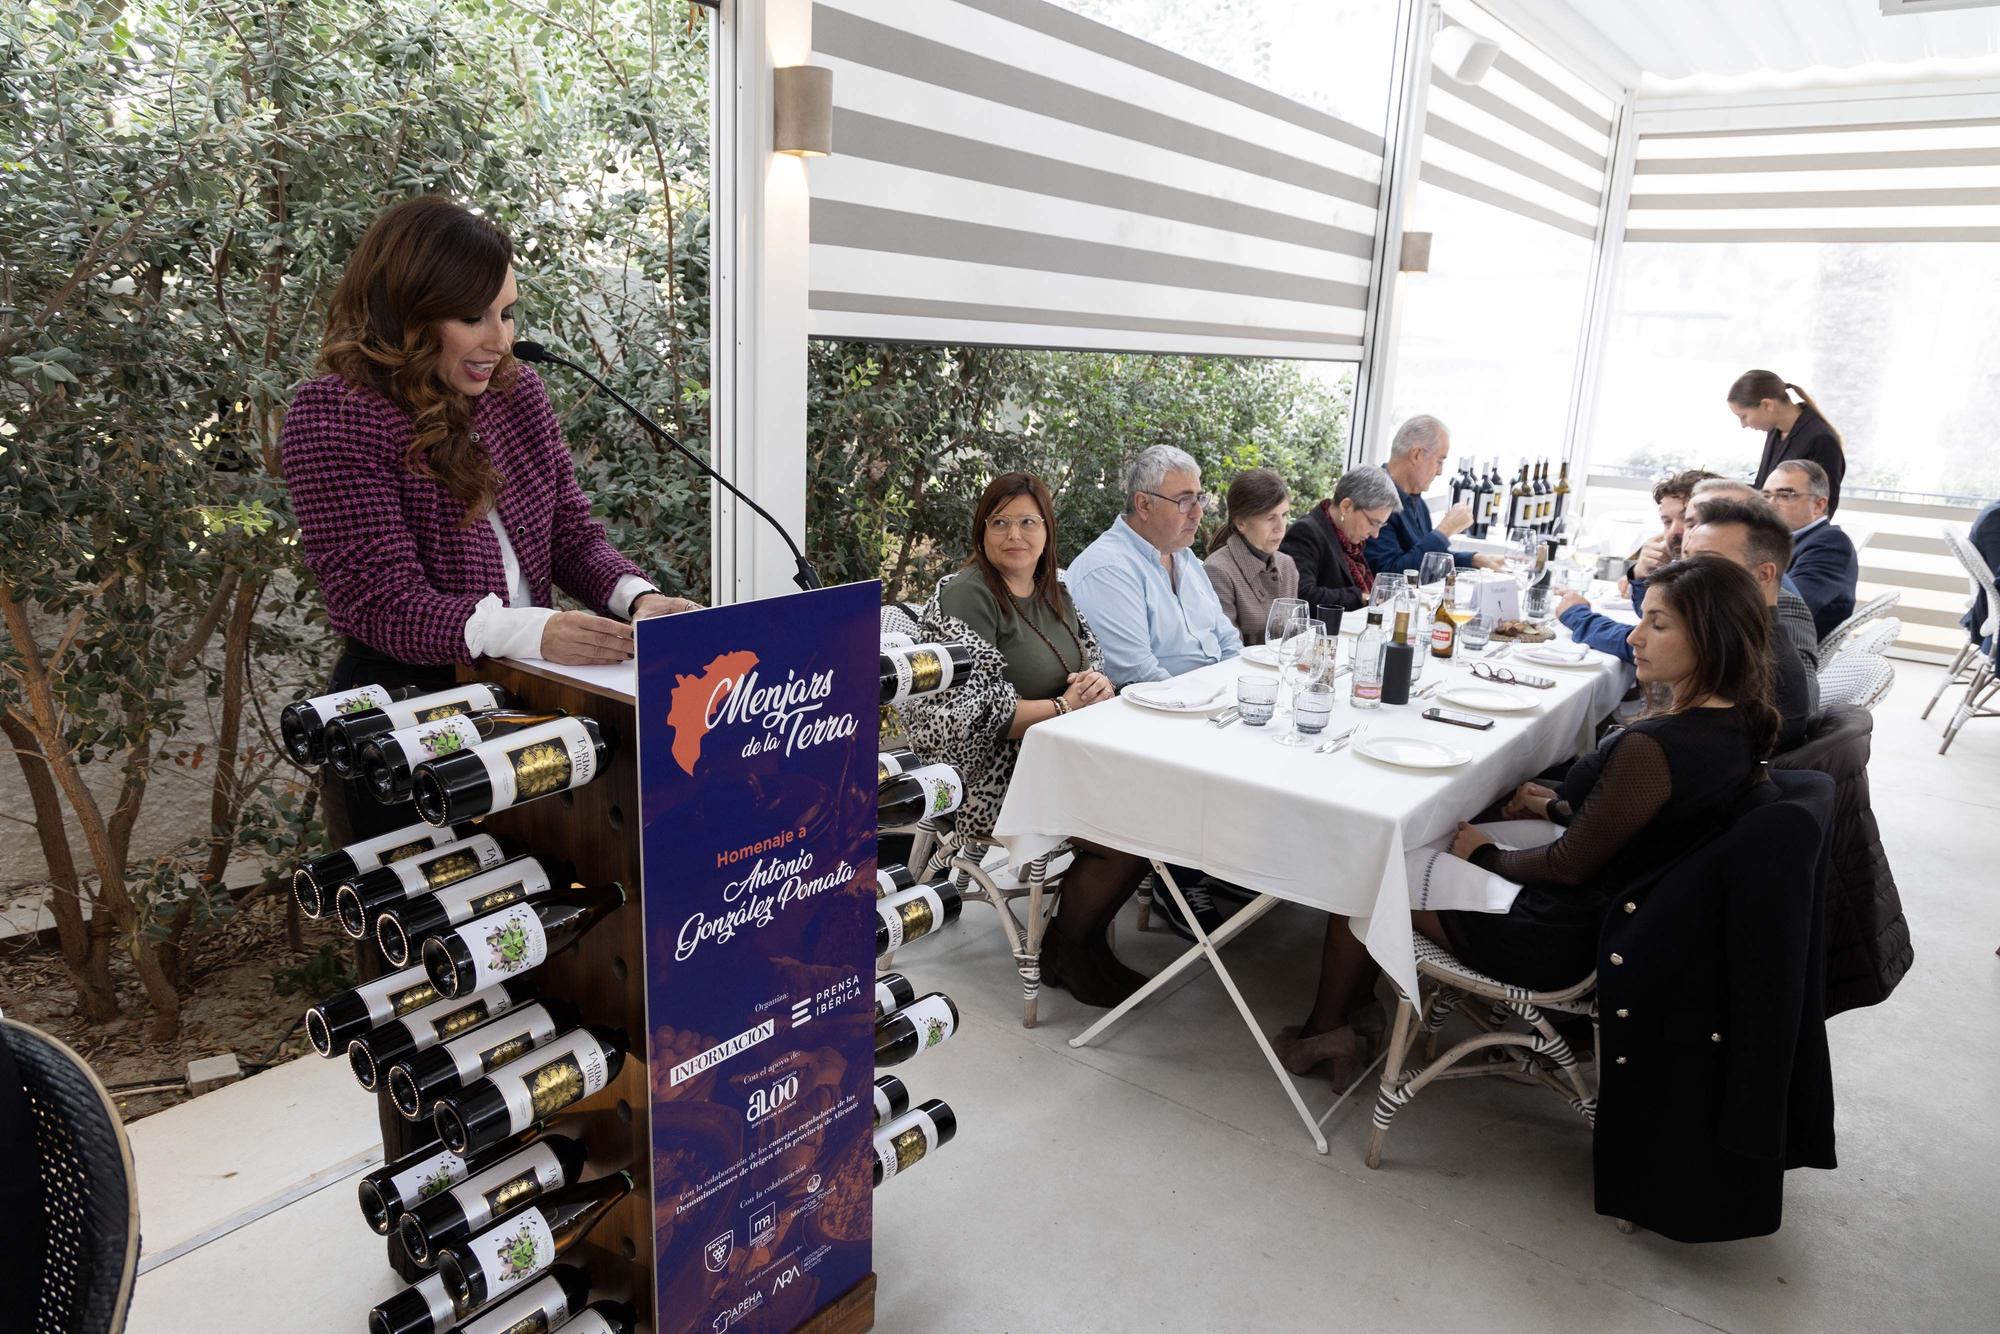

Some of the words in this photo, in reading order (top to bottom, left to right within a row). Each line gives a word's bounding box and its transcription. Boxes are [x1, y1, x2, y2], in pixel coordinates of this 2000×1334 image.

[704, 669, 834, 730] Menjars
[741, 736, 762, 758] de
[763, 732, 781, 751] la
[779, 703, 859, 758] Terra
[573, 750, 582, 773] HILL
[577, 736, 590, 780] TARIMA
[717, 829, 794, 868] Homenaje
[798, 826, 808, 839] a
[723, 848, 814, 903] Antonio
[674, 894, 775, 962] González
[777, 860, 857, 911] Pomata
[754, 992, 790, 1013] Organiza:
[816, 975, 860, 1002] PRENSA
[585, 1063, 594, 1085] HILL
[588, 1048, 602, 1090] TARIMA
[674, 1022, 774, 1083] INFORMACIÓN
[743, 1071, 759, 1085] Con
[759, 1066, 768, 1078] el
[768, 1055, 790, 1073] apoyo
[675, 1174, 739, 1215] Denominaciones
[739, 1166, 749, 1178] de
[750, 1153, 774, 1173] Origen
[774, 1143, 785, 1157] de
[784, 1138, 792, 1150] la
[790, 1121, 825, 1149] provincia
[823, 1113, 834, 1126] de
[833, 1101, 860, 1121] Alicante
[679, 1188, 696, 1201] Con
[695, 1183, 704, 1193] la
[704, 1156, 748, 1189] colaboración
[748, 1152, 758, 1162] de
[758, 1144, 770, 1156] los
[768, 1128, 798, 1150] consejos
[797, 1105, 837, 1131] reguladores
[836, 1098, 846, 1109] de
[845, 1094, 857, 1105] las
[739, 1196, 755, 1210] Con
[755, 1191, 764, 1200] la
[763, 1164, 808, 1197] colaboración
[708, 1233, 732, 1251] BOCOPA
[730, 1290, 763, 1318] APEHA
